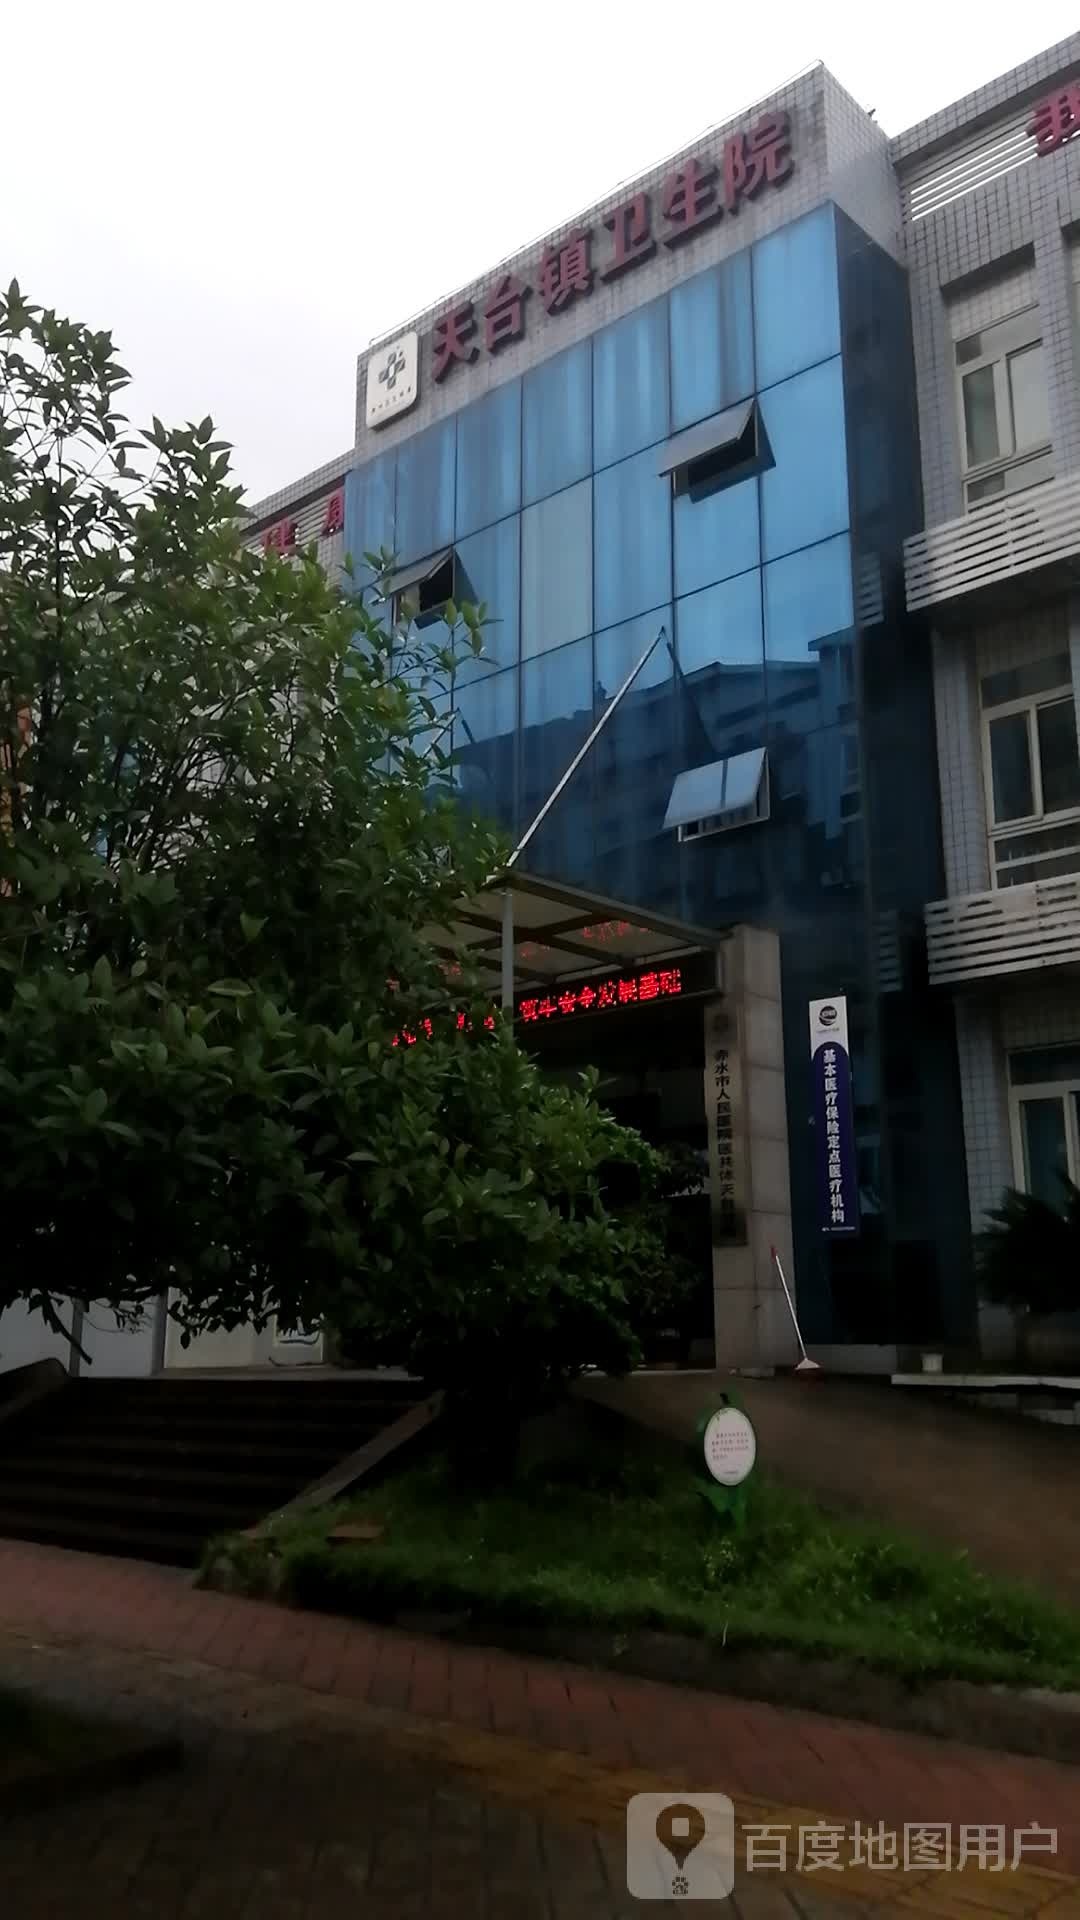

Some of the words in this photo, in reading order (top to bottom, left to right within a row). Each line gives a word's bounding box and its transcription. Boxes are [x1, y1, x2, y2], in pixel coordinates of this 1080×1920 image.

[431, 110, 793, 382] 天台镇卫生院
[822, 1049, 846, 1223] 基本医疗保险定点医疗机构
